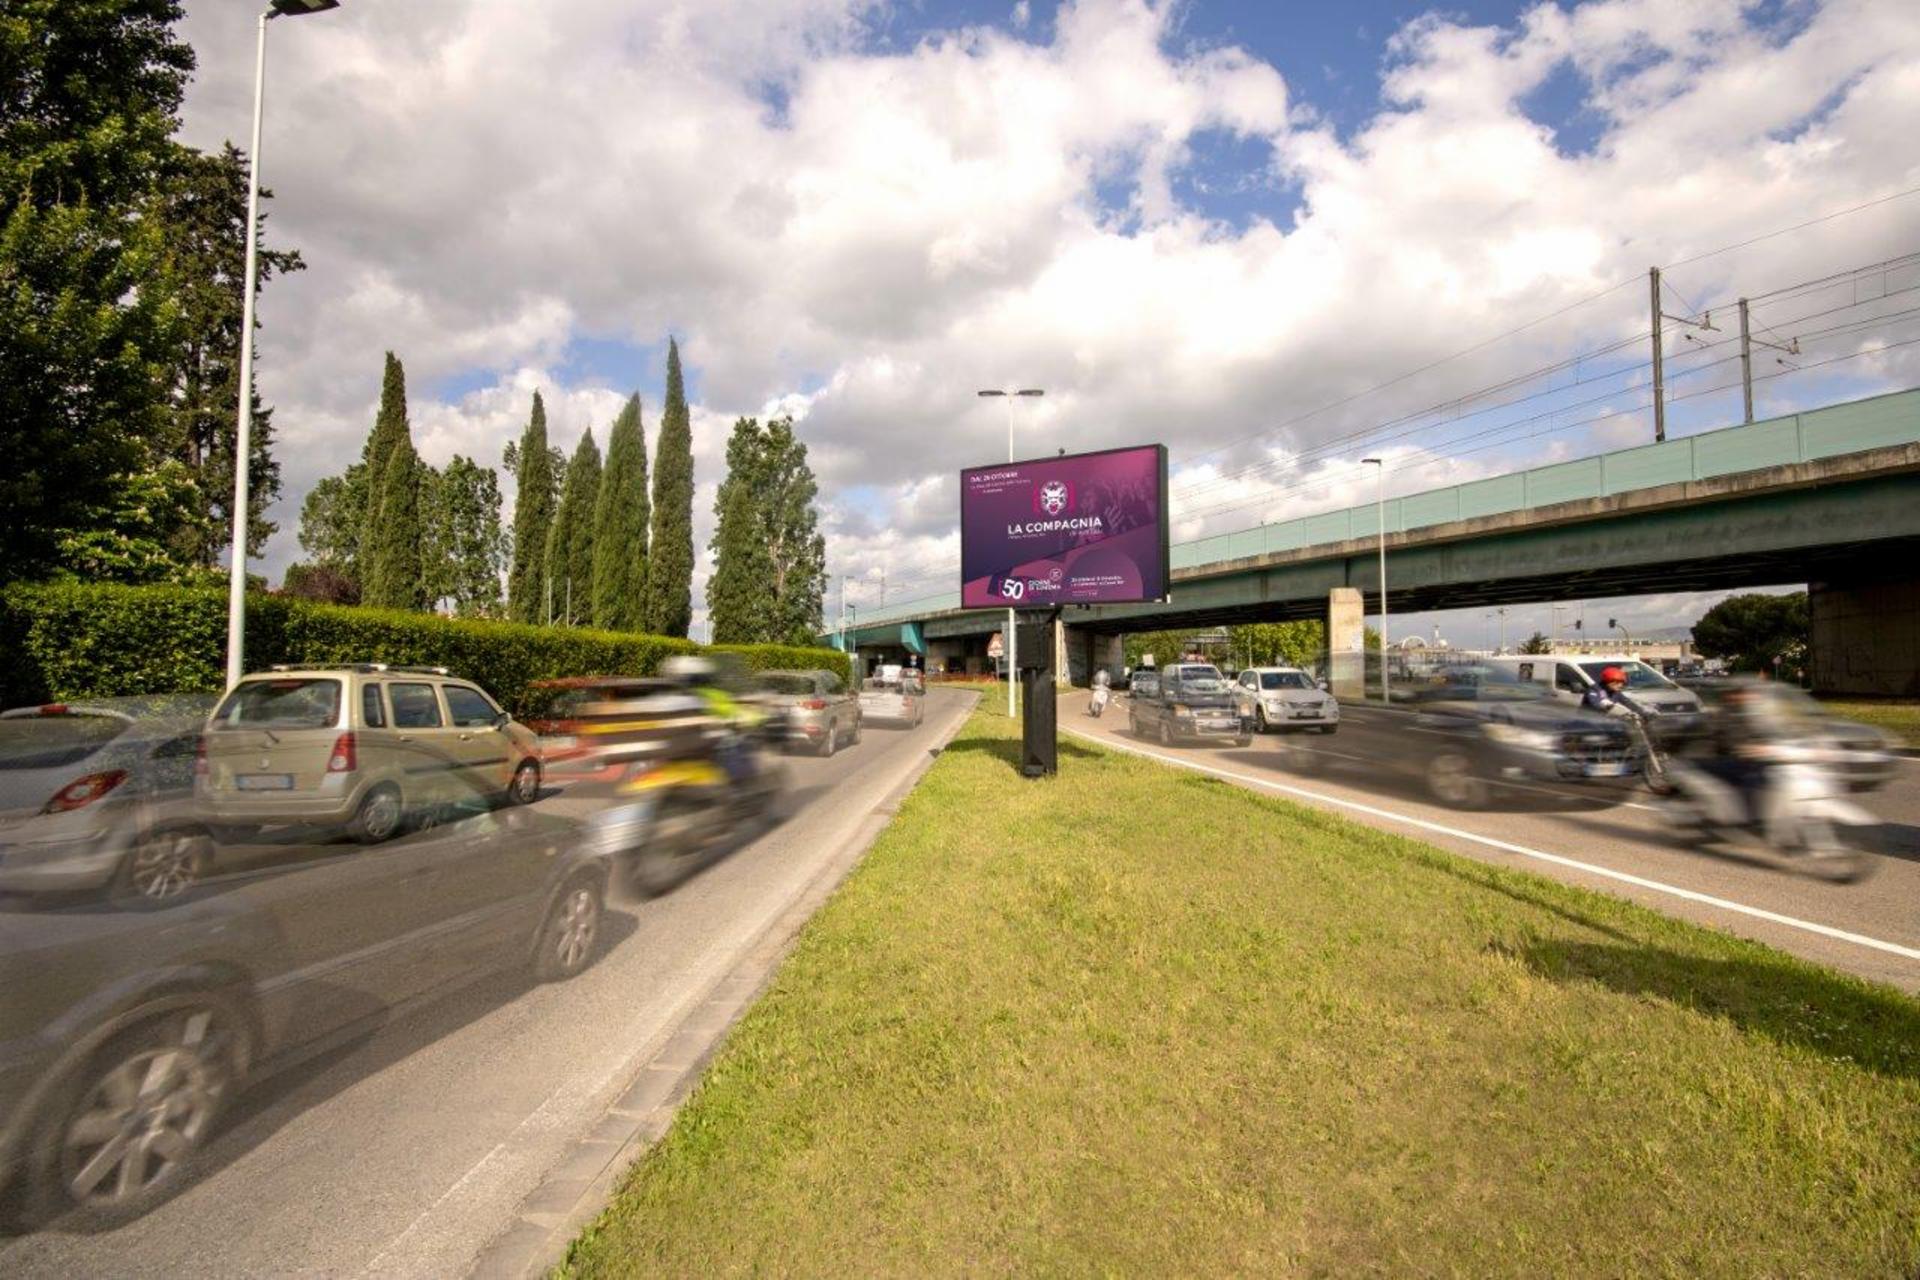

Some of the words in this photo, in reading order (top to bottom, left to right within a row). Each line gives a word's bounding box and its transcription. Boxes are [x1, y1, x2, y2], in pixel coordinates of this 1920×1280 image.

[1008, 524, 1023, 535] LA
[1025, 516, 1102, 534] COMPAGNIA
[1002, 578, 1024, 600] 50
